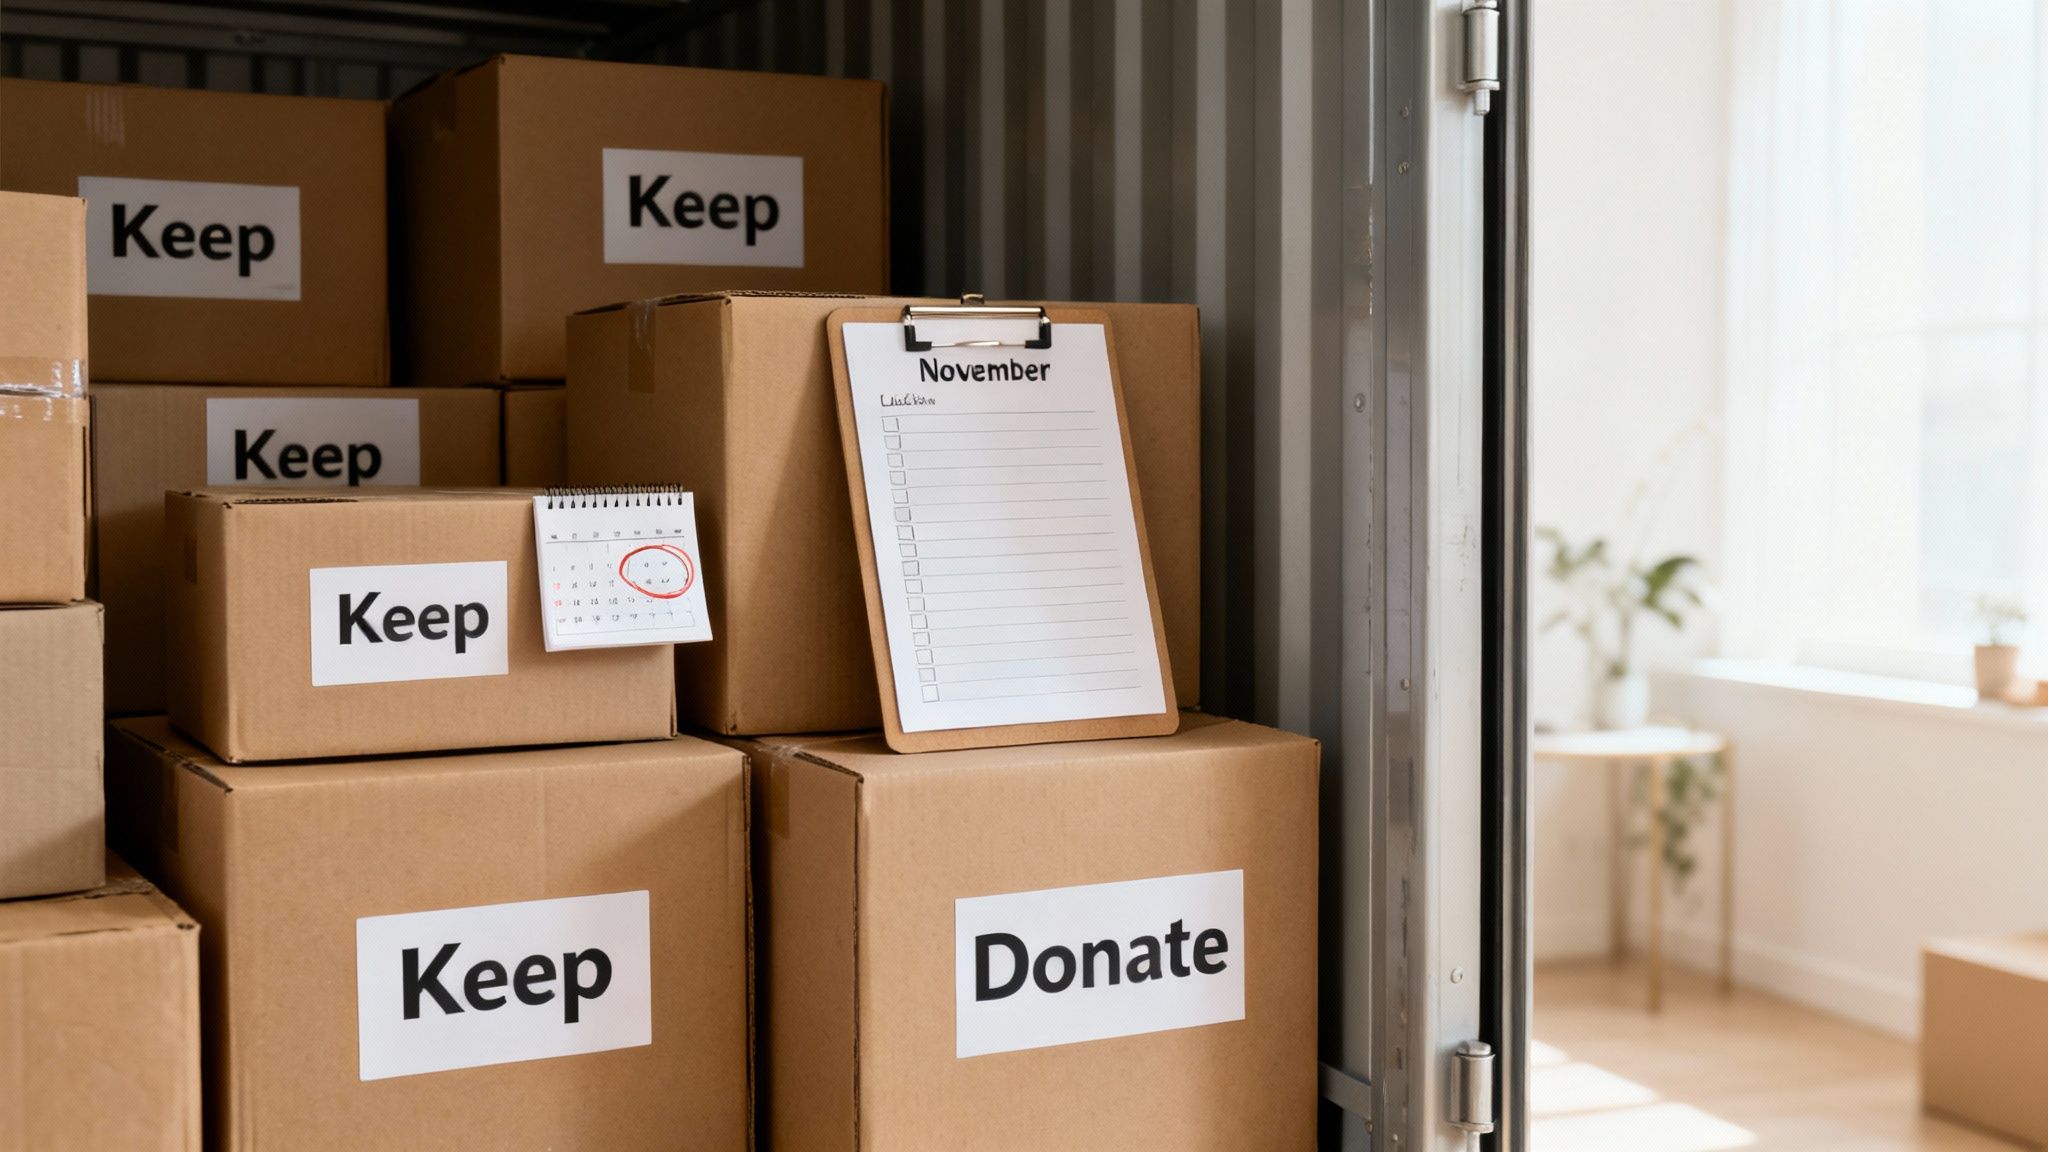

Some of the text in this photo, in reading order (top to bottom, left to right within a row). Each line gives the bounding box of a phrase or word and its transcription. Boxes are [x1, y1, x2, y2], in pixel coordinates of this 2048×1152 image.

[111, 203, 275, 278] Keep
[629, 175, 780, 247] Keep
[919, 357, 1051, 383] November
[234, 429, 383, 486] Keep
[338, 591, 490, 654] Keep
[402, 942, 613, 1024] Keep
[974, 918, 1229, 1002] Donate
